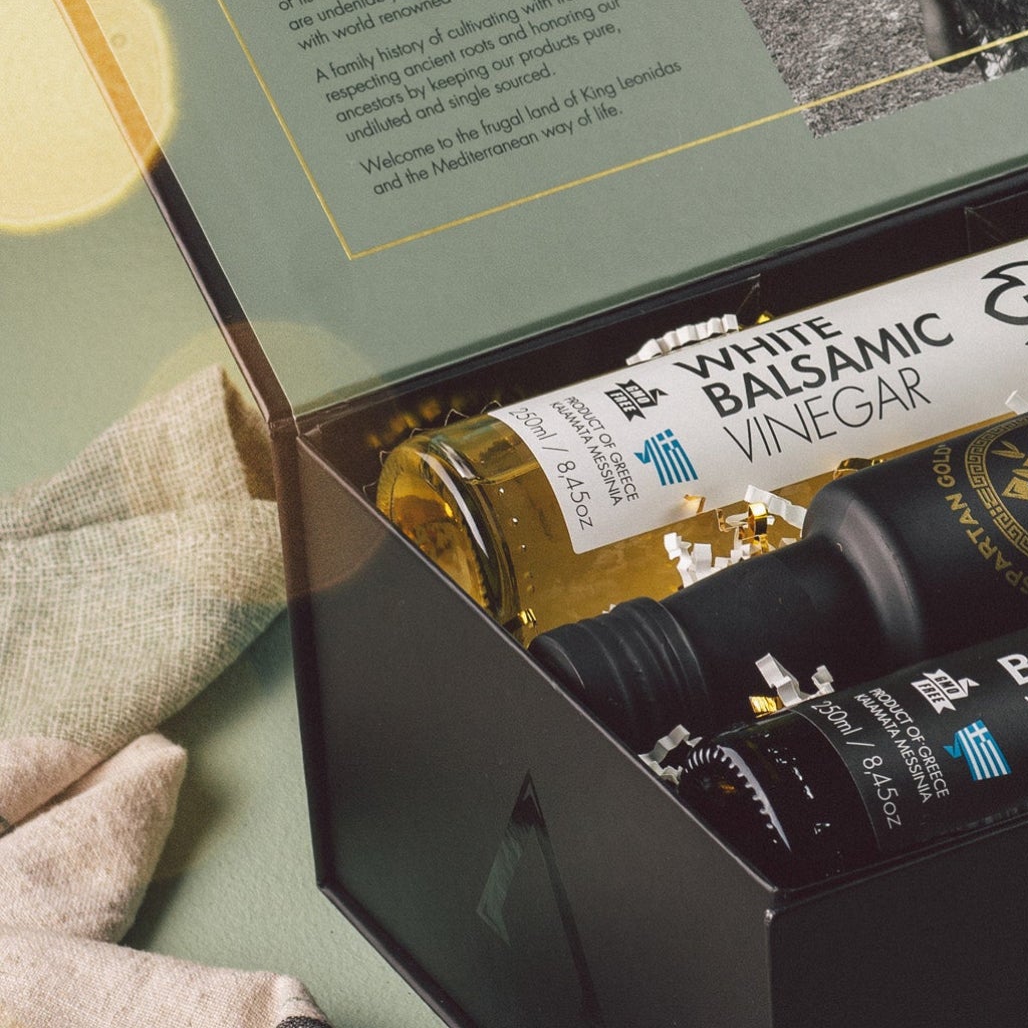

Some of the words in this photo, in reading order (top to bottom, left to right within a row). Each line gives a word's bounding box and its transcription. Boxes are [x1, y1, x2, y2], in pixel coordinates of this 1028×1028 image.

[288, 15, 314, 31] are
[296, 28, 331, 51] with
[331, 12, 376, 39] world
[315, 67, 330, 84] A
[328, 52, 375, 78] family
[374, 38, 424, 63] history
[428, 26, 444, 46] of
[446, 8, 520, 40] cultivating
[325, 70, 402, 103] respecting
[403, 49, 457, 77] ancient
[459, 38, 496, 59] roots
[497, 23, 528, 46] and
[527, 7, 596, 36] honoring
[335, 92, 404, 123] ancestors
[403, 84, 426, 100] by
[426, 64, 490, 92] keeping
[491, 55, 515, 71] our
[517, 34, 580, 67] products
[582, 22, 622, 46] pure,
[345, 107, 413, 143] undiluted
[414, 96, 446, 120] and
[447, 84, 491, 109] single
[494, 61, 556, 94] sourced.
[358, 143, 435, 175] Welcome
[436, 137, 454, 150] to
[454, 126, 480, 144] the
[479, 107, 525, 136] frugal
[523, 95, 561, 120] land
[563, 88, 579, 108] of
[578, 83, 617, 102] King
[615, 60, 682, 90] Leonidas
[372, 171, 404, 195] and
[404, 167, 430, 184] the
[430, 132, 540, 176] Mediterranean
[540, 119, 573, 138] way
[576, 107, 593, 127] of
[592, 102, 623, 121] life.
[674, 316, 843, 379] WHITE
[701, 313, 954, 418] BALSAMIC
[550, 402, 592, 444] KALAMATA
[587, 445, 622, 506] MESSINIA
[564, 396, 604, 433] PRODUCT
[600, 433, 616, 449] OF
[610, 452, 639, 502] GREECE
[723, 366, 932, 463] VINEGAR
[509, 407, 556, 441] 250ml
[557, 460, 593, 531] 8,45oz
[918, 682, 945, 703] FREE
[935, 676, 959, 694] GMO
[811, 700, 863, 736] 250ml
[862, 755, 902, 829] 8,45oz
[854, 694, 900, 739] KALAMATA
[895, 739, 932, 803] MESSINIA
[869, 688, 913, 726] PRODUCT
[918, 745, 949, 798] GREECE
